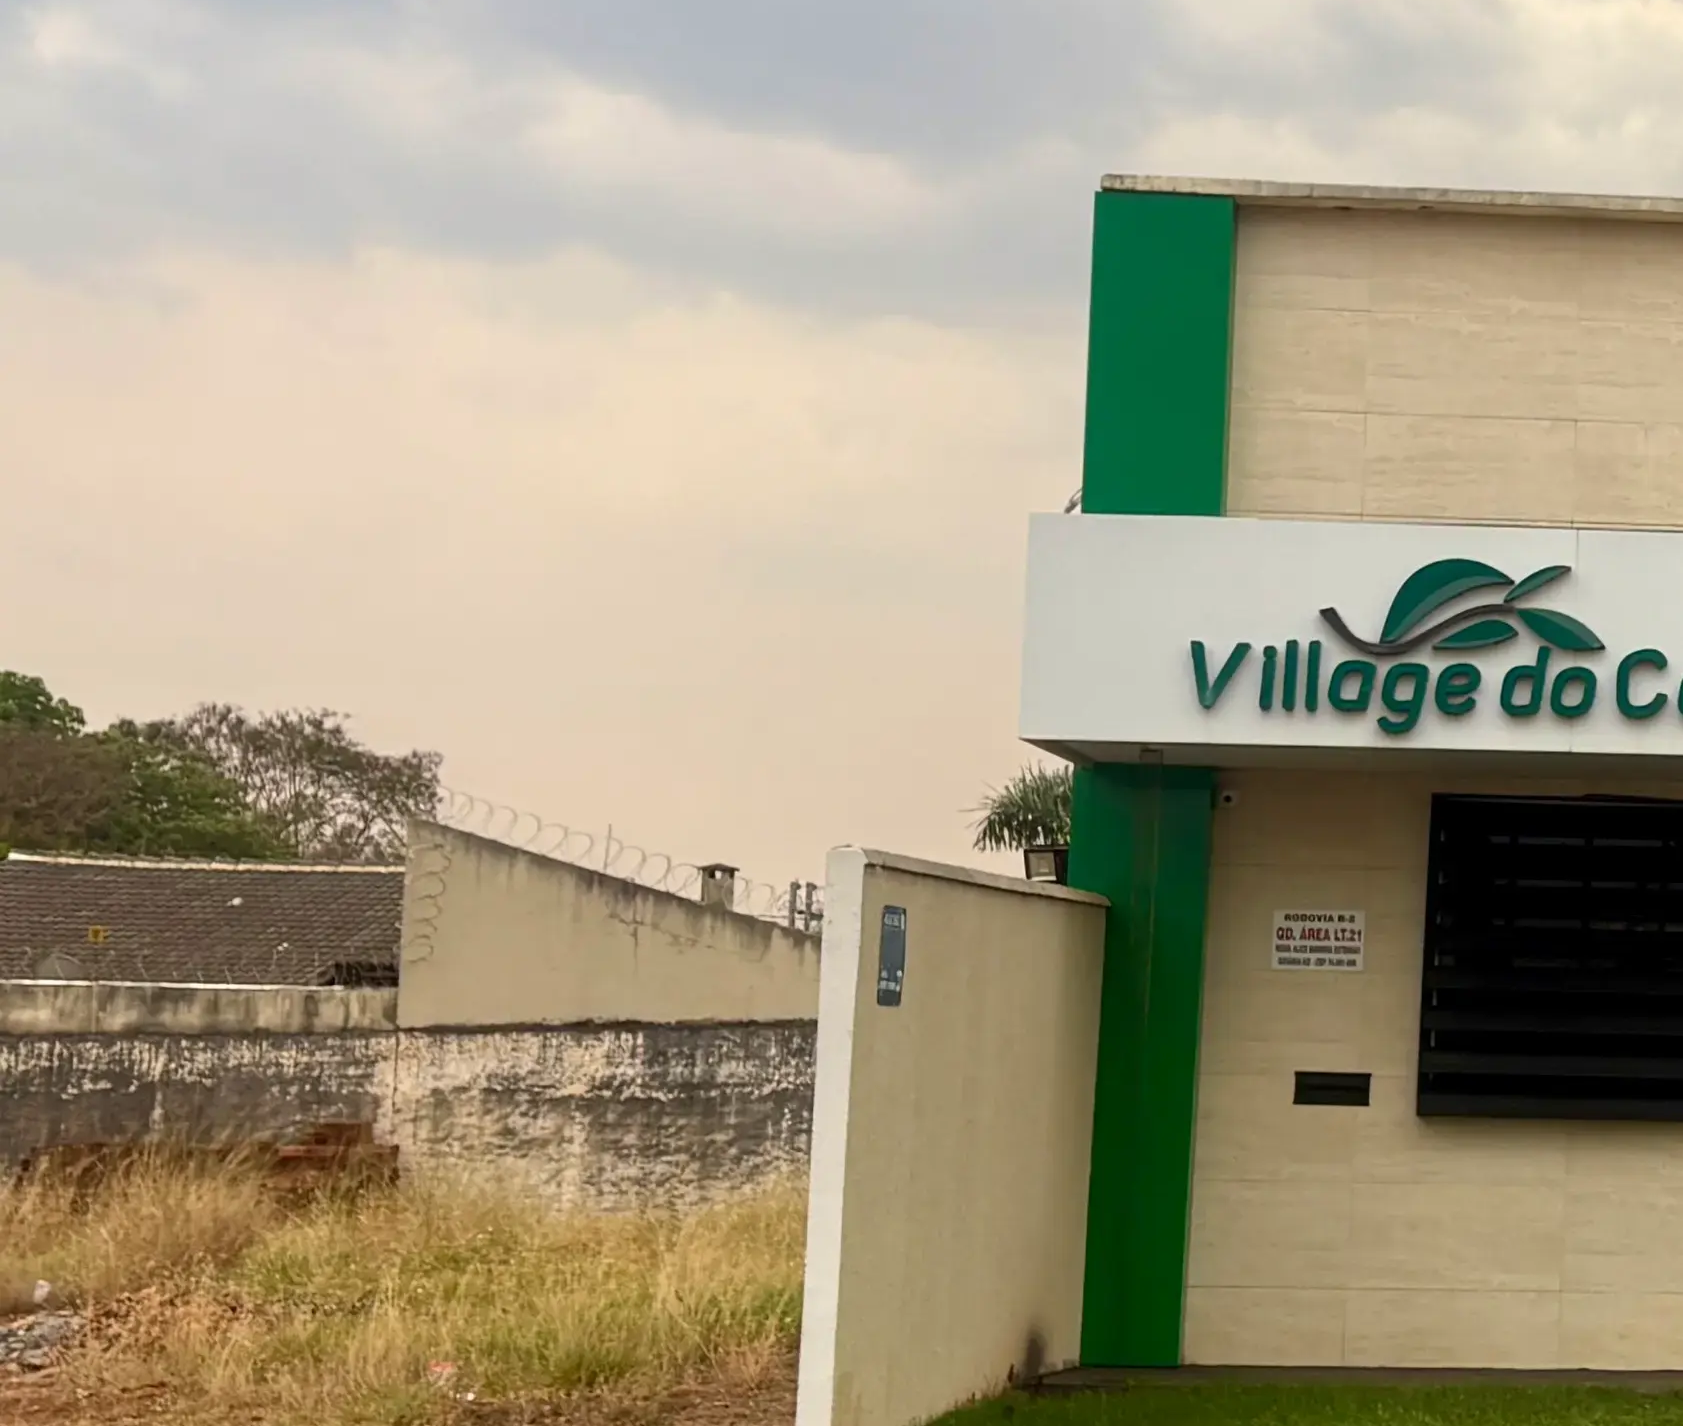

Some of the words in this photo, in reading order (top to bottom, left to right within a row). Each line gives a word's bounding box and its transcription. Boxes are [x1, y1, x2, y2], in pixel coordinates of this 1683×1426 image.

[1190, 639, 1482, 735] Village
[1499, 646, 1598, 719] do
[1284, 913, 1334, 923] RODOVIA
[1276, 926, 1296, 941] QD.
[1299, 924, 1331, 941] ÁREA
[1334, 929, 1362, 942] LT.21
